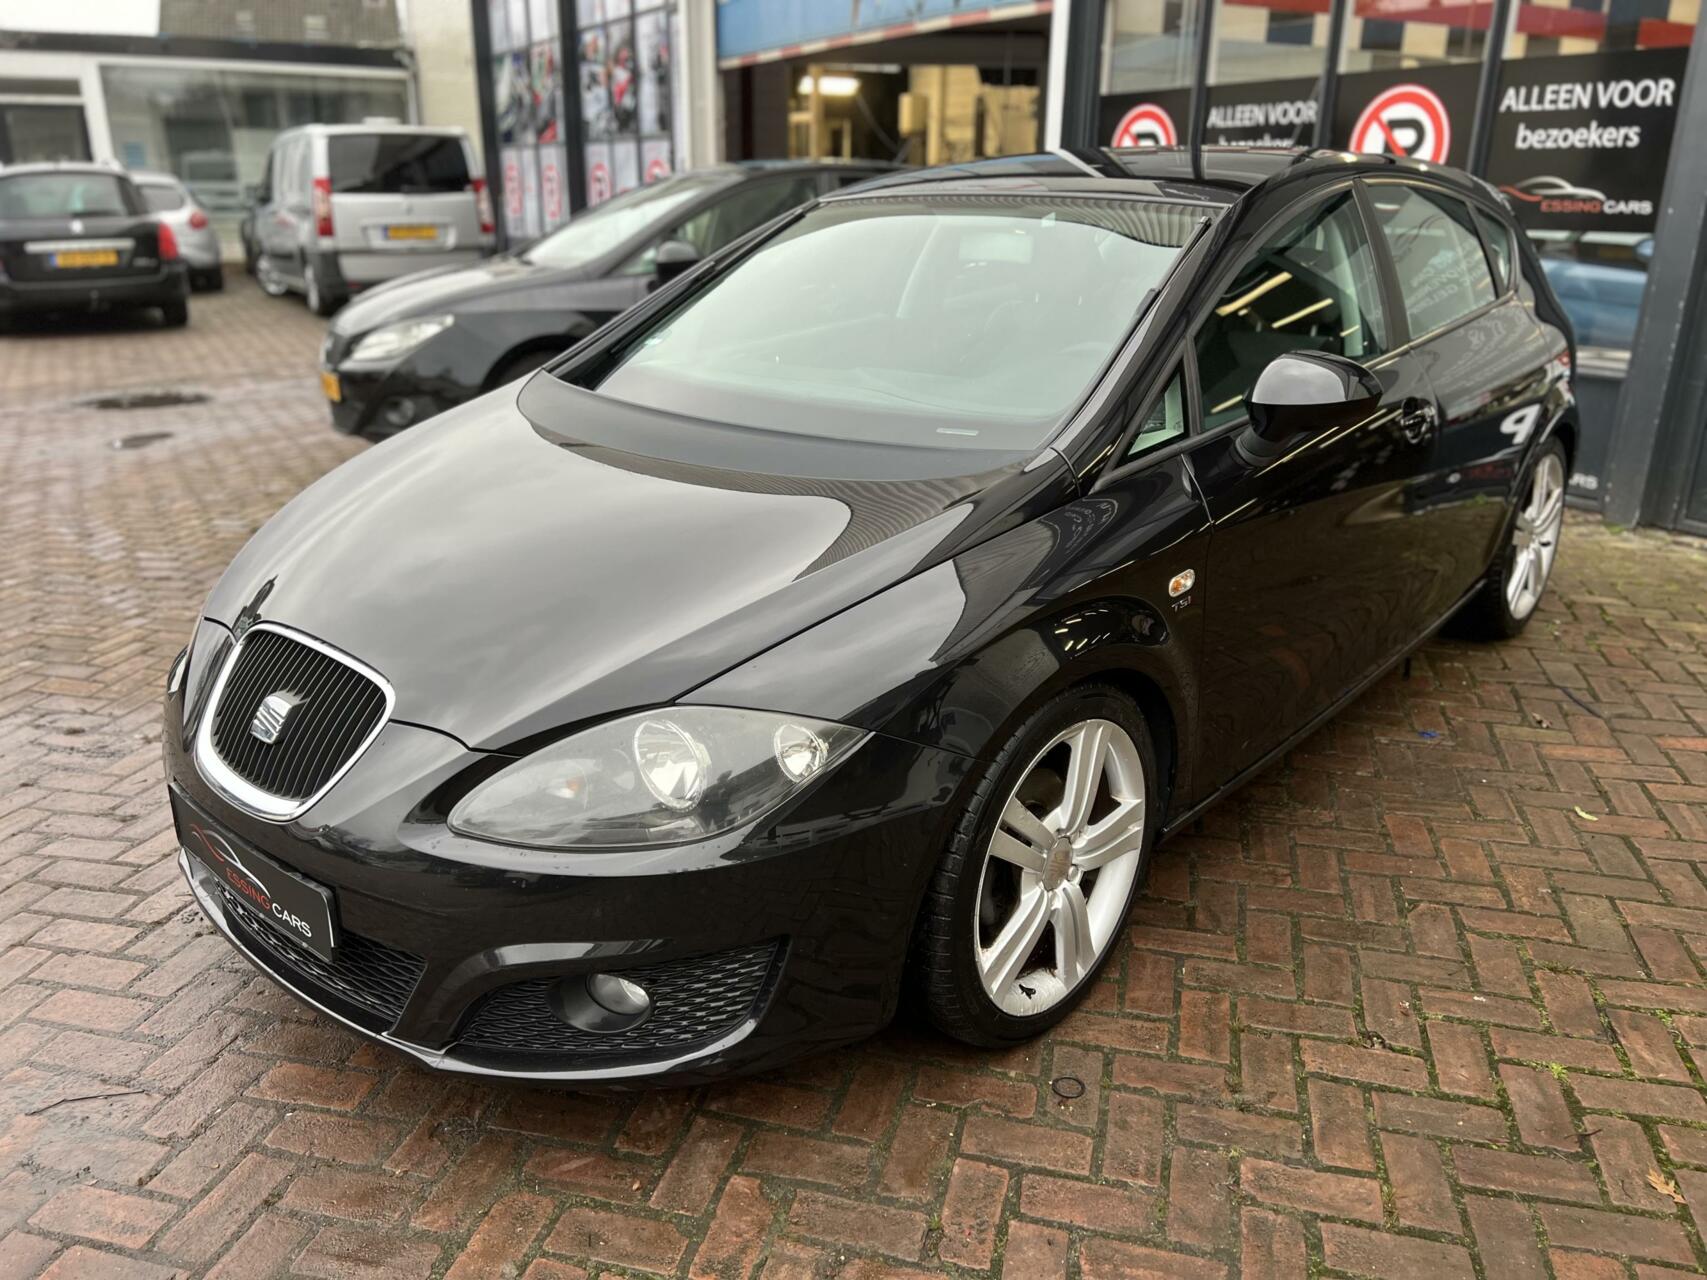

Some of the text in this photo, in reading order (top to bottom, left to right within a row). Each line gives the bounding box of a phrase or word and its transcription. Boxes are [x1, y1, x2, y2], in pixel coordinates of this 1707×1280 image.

[1499, 78, 1676, 113] ALLEEN VOOR
[1206, 100, 1319, 128] ALLEEN VOOR
[1515, 120, 1641, 150] bezoekers
[1540, 199, 1654, 216] ESSING CARS
[1171, 595, 1192, 613] TSI
[225, 867, 312, 938] ESSING CARS
